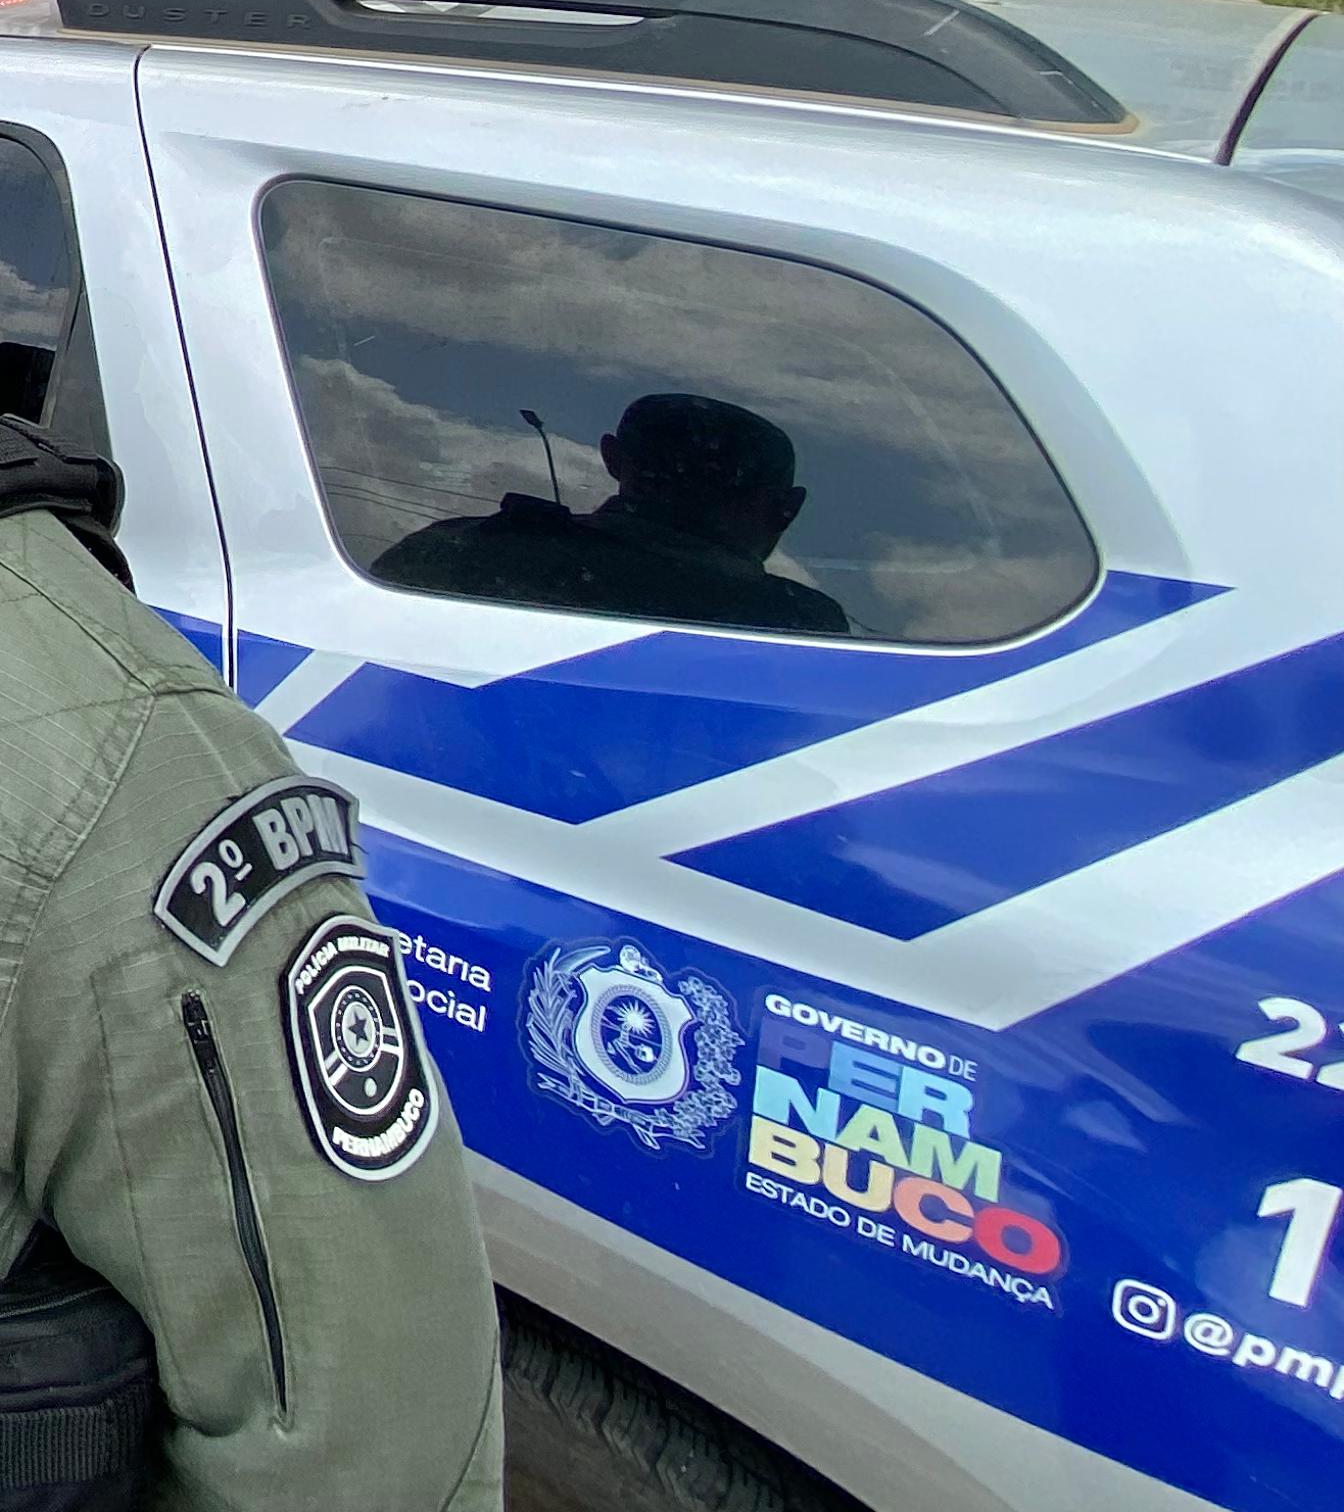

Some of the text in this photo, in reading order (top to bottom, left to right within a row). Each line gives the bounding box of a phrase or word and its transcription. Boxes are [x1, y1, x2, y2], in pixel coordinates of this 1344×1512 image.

[252, 794, 349, 871] BPM
[337, 937, 390, 958] MILITAR
[758, 1021, 974, 1139] PER
[765, 994, 979, 1082] GOVERNO DE
[333, 1087, 424, 1158] PERNAMBUCO
[752, 1065, 1002, 1203] NAM
[749, 1115, 1061, 1274] BUCO
[746, 1172, 1055, 1310] ESTADO DE MUDANÇA
[1183, 1312, 1344, 1400] @pm
